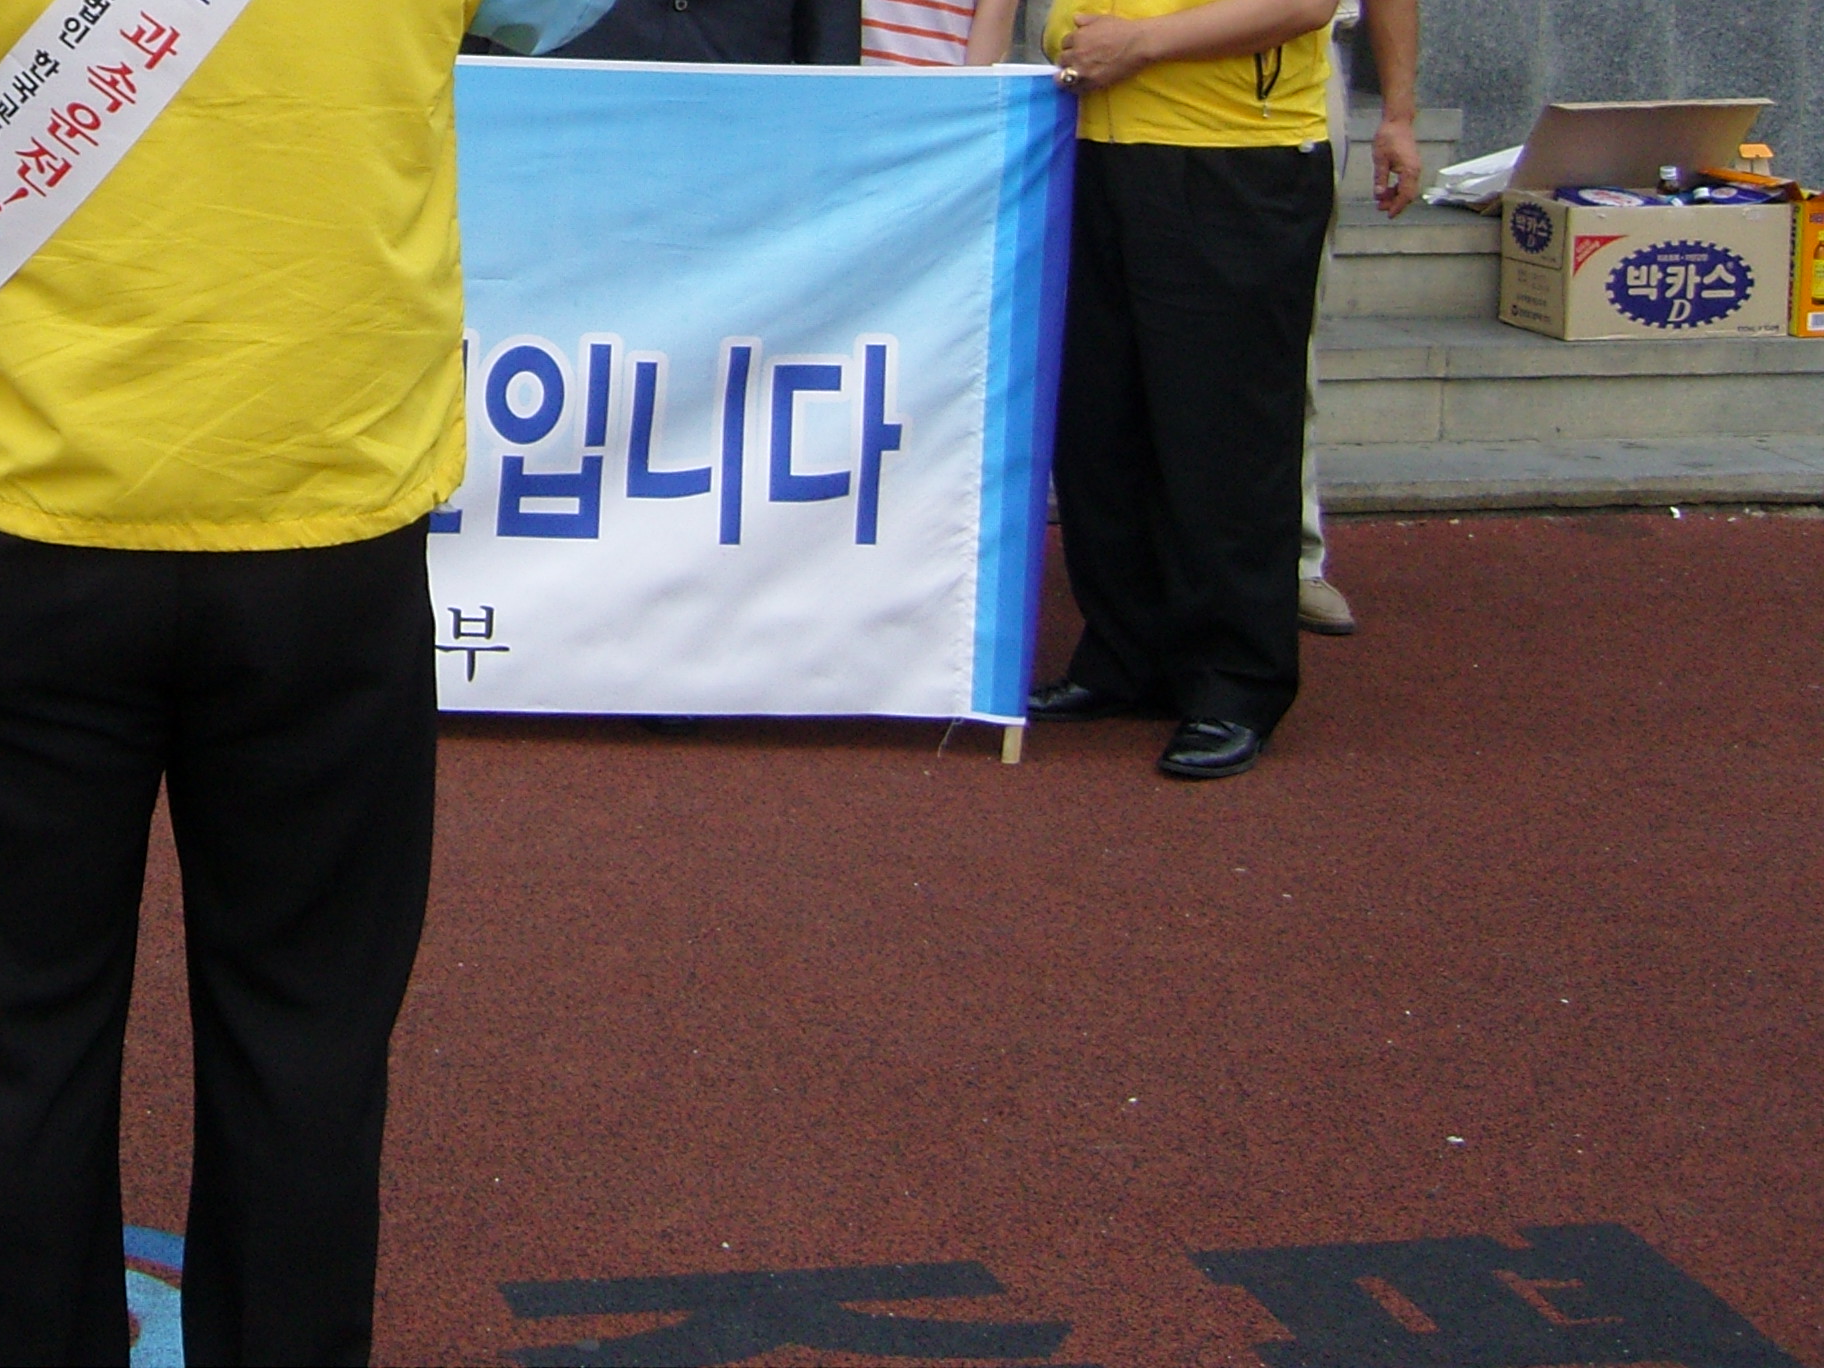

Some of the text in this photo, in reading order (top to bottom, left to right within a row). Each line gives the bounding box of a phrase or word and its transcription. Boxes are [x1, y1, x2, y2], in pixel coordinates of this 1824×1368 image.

[1626, 264, 1737, 300] 박카스
[1667, 298, 1693, 322] D
[429, 338, 903, 546] 입니다
